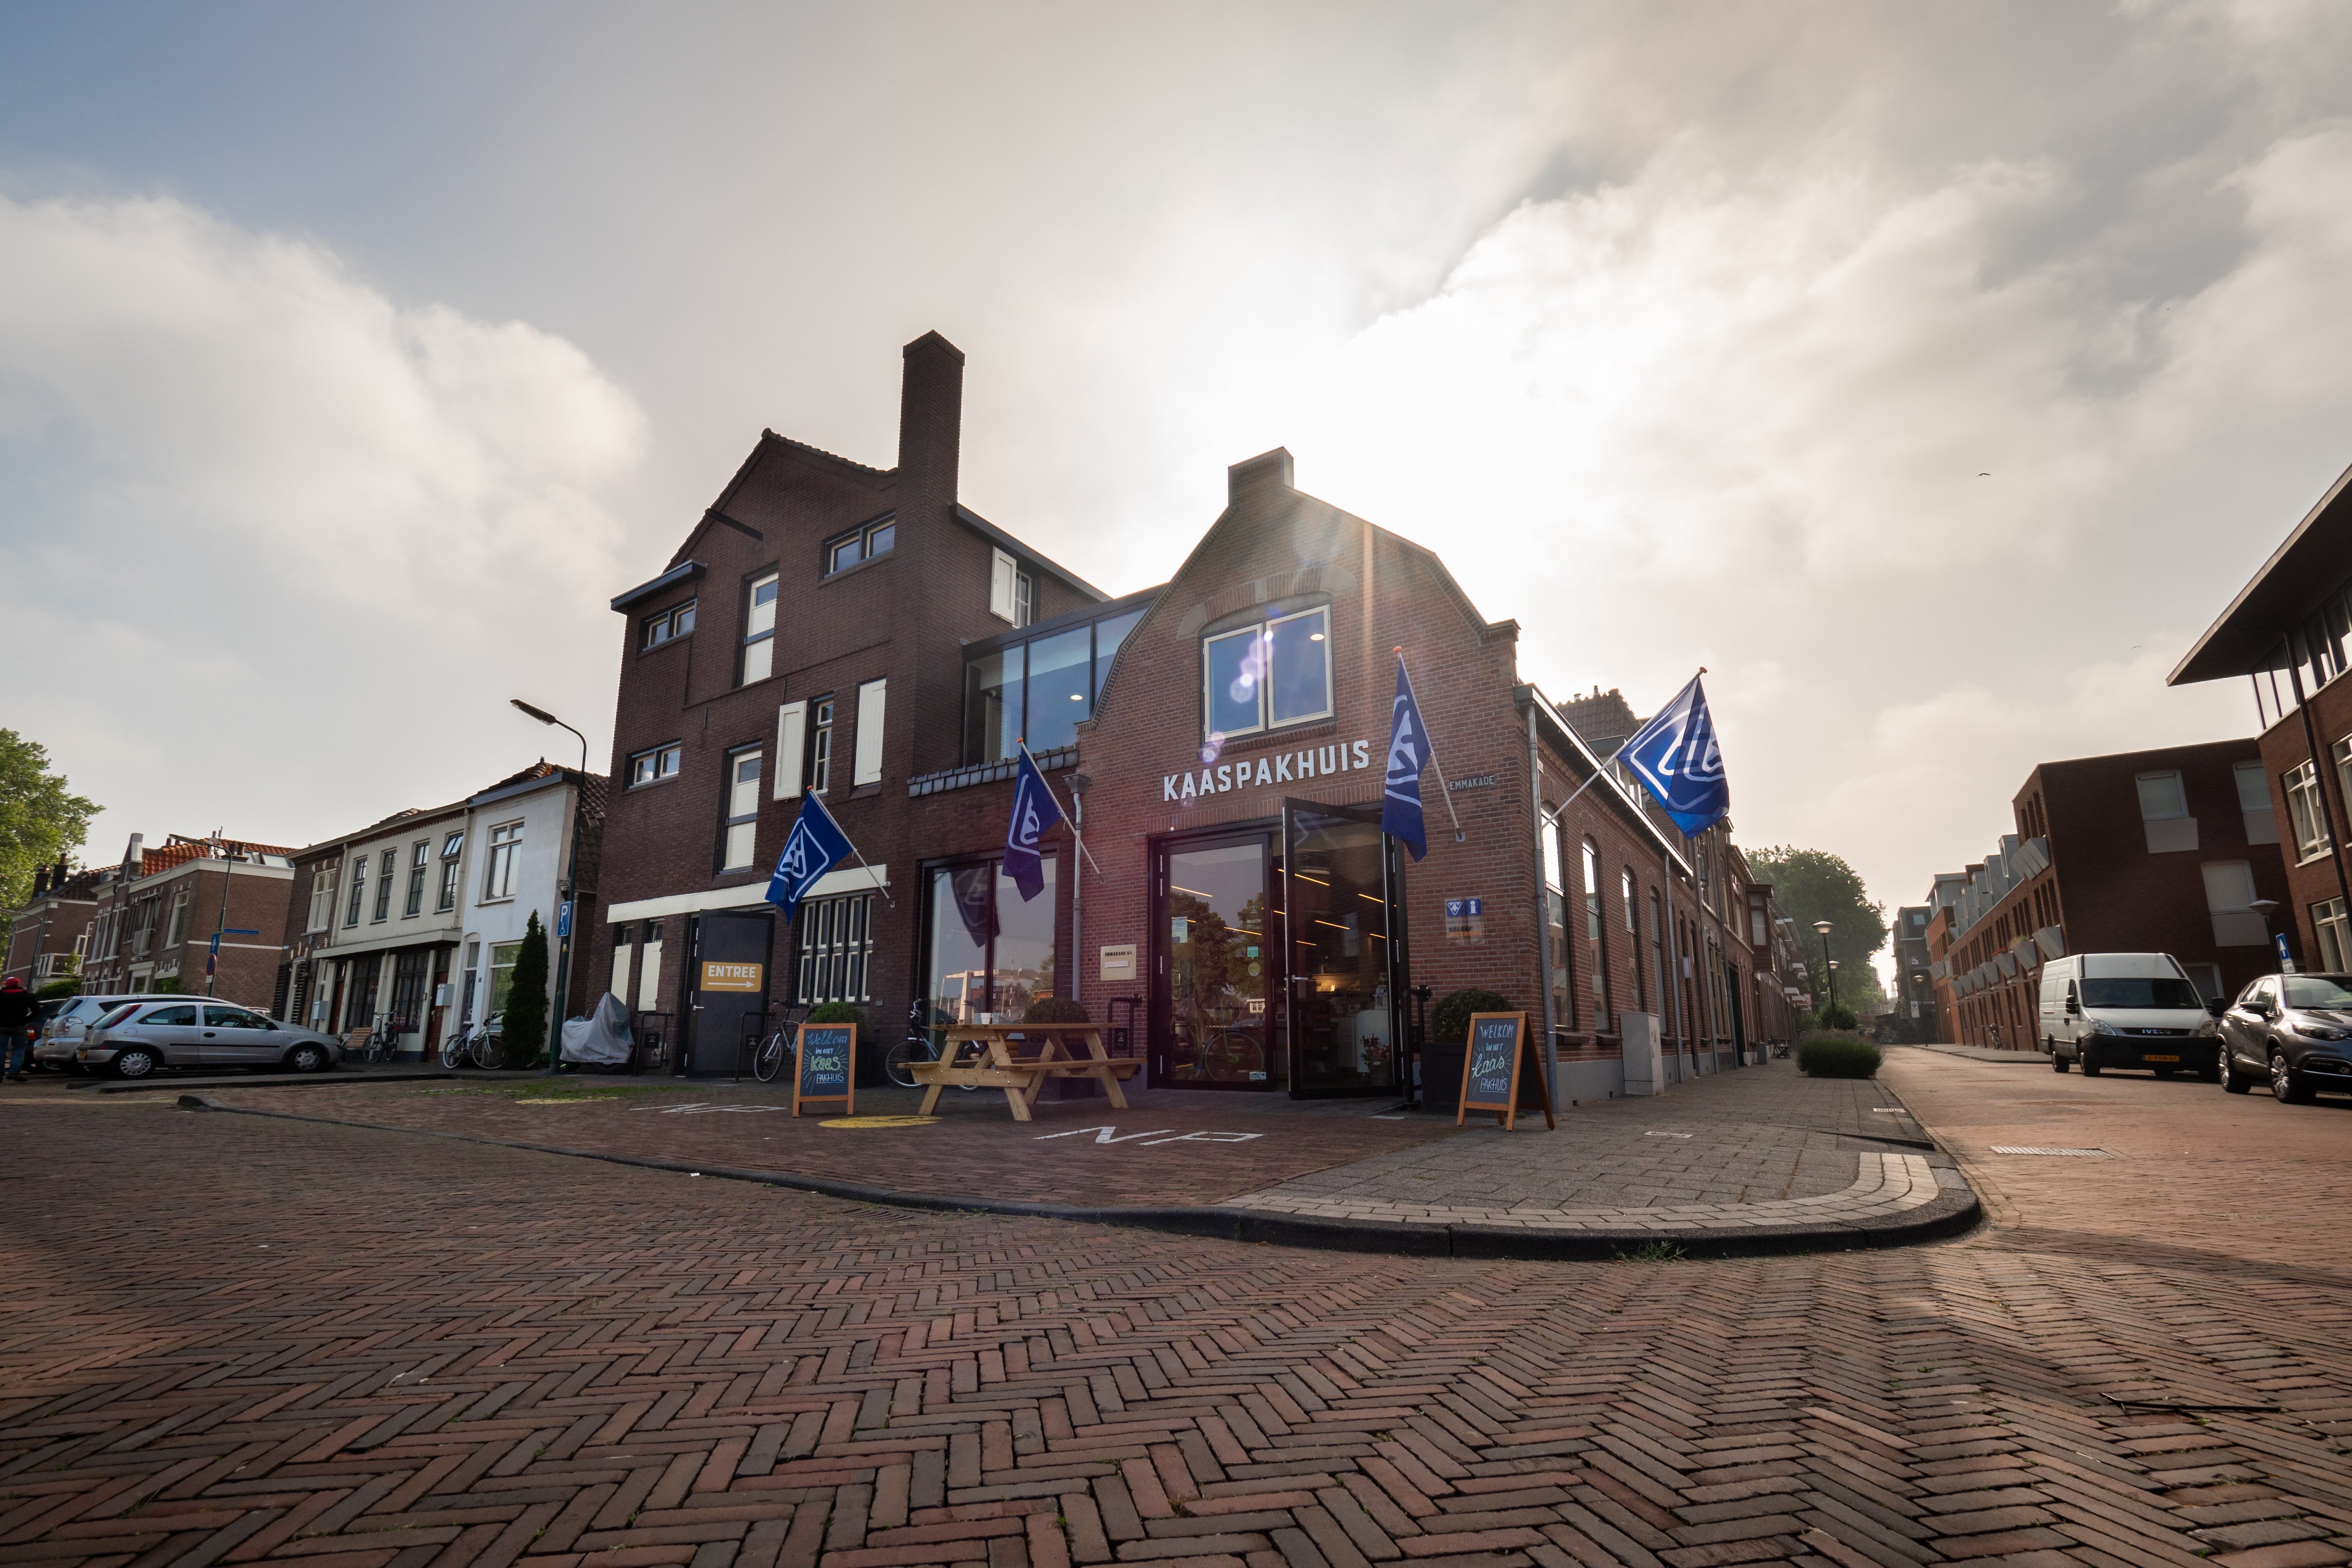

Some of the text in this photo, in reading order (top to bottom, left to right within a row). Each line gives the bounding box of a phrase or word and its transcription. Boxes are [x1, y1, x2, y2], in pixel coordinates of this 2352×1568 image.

[1164, 740, 1369, 801] KAASPAKHUIS
[1449, 775, 1495, 790] EMMAKADE
[560, 905, 568, 922] P
[708, 965, 756, 978] ENTREE
[807, 1030, 848, 1045] Welkom
[1480, 1024, 1514, 1039] WELKOM
[816, 1072, 844, 1083] PAKHUIS
